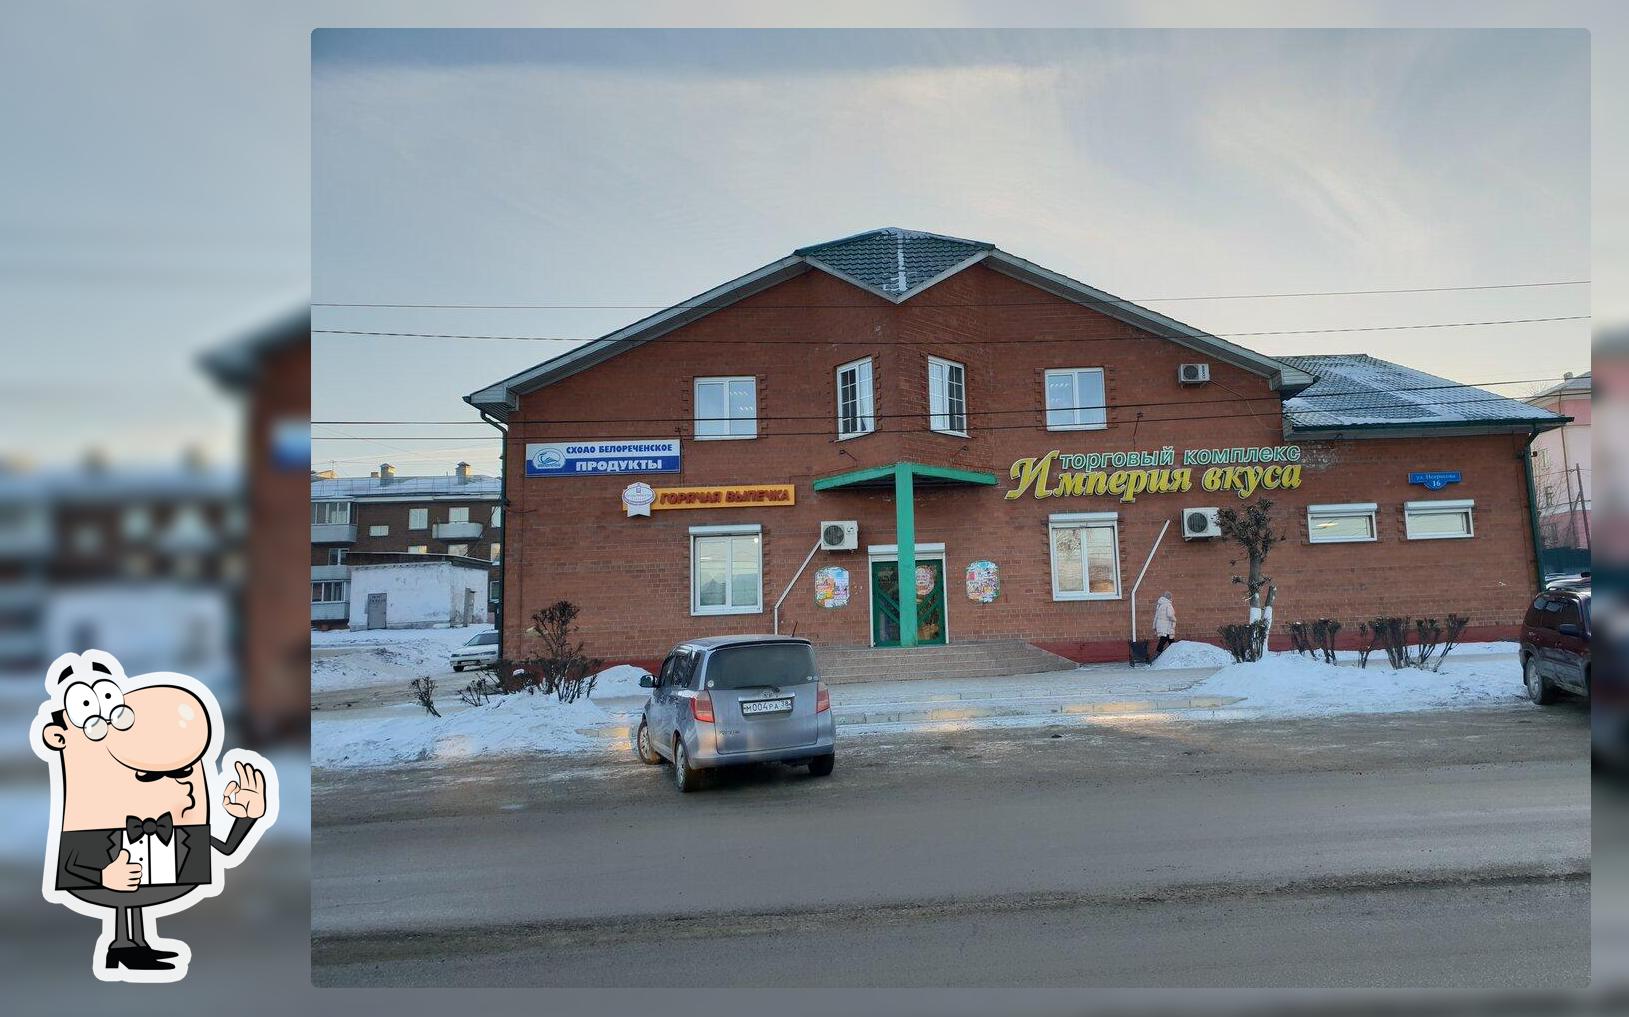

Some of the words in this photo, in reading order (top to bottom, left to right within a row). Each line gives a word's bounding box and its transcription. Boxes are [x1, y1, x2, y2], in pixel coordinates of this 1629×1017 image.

[566, 444, 595, 455] СХОАО
[599, 443, 673, 454] БЕЛОРЕЧЕНСКОЕ
[1060, 446, 1174, 471] торговый
[1184, 445, 1301, 465] комплекс
[576, 459, 662, 473] ПРОДУКТЫ
[1004, 450, 1193, 503] Империя
[1202, 464, 1302, 499] вкуса
[1432, 479, 1441, 487] 16
[660, 491, 721, 505] ГОРЯЧАЯ
[725, 489, 790, 503] ВЫПЕЧКА
